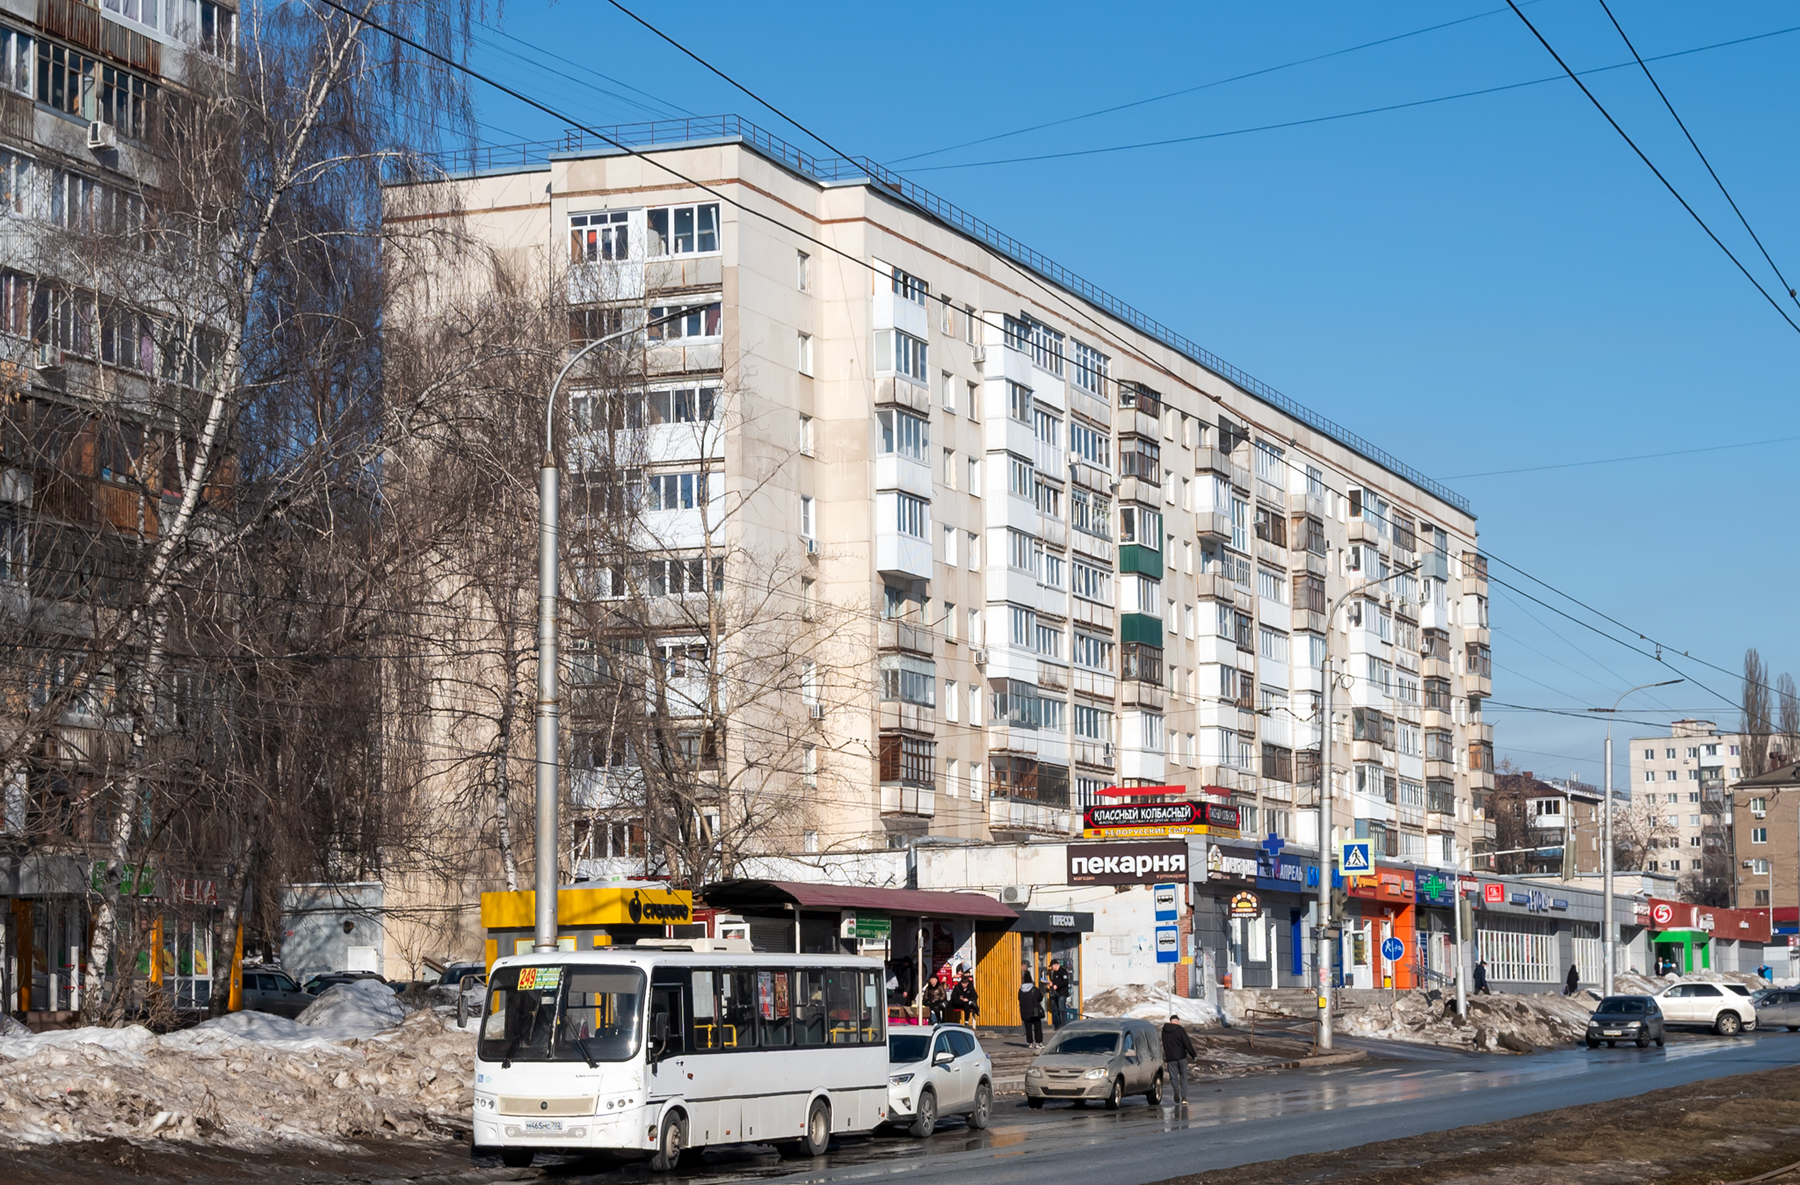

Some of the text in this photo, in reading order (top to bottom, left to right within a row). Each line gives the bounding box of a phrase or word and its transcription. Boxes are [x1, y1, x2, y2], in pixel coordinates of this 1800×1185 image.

[1094, 805, 1191, 821] КЛАССНЫЙ КОЛБАСНЫЙ
[1105, 826, 1195, 836] БЕЛОРУССКИЕ СЫРЫ
[1071, 854, 1186, 877] пекарня
[1280, 863, 1303, 882] АПРЕЛЬ
[1052, 914, 1076, 927] ПРЕССА
[520, 968, 537, 986] 249
